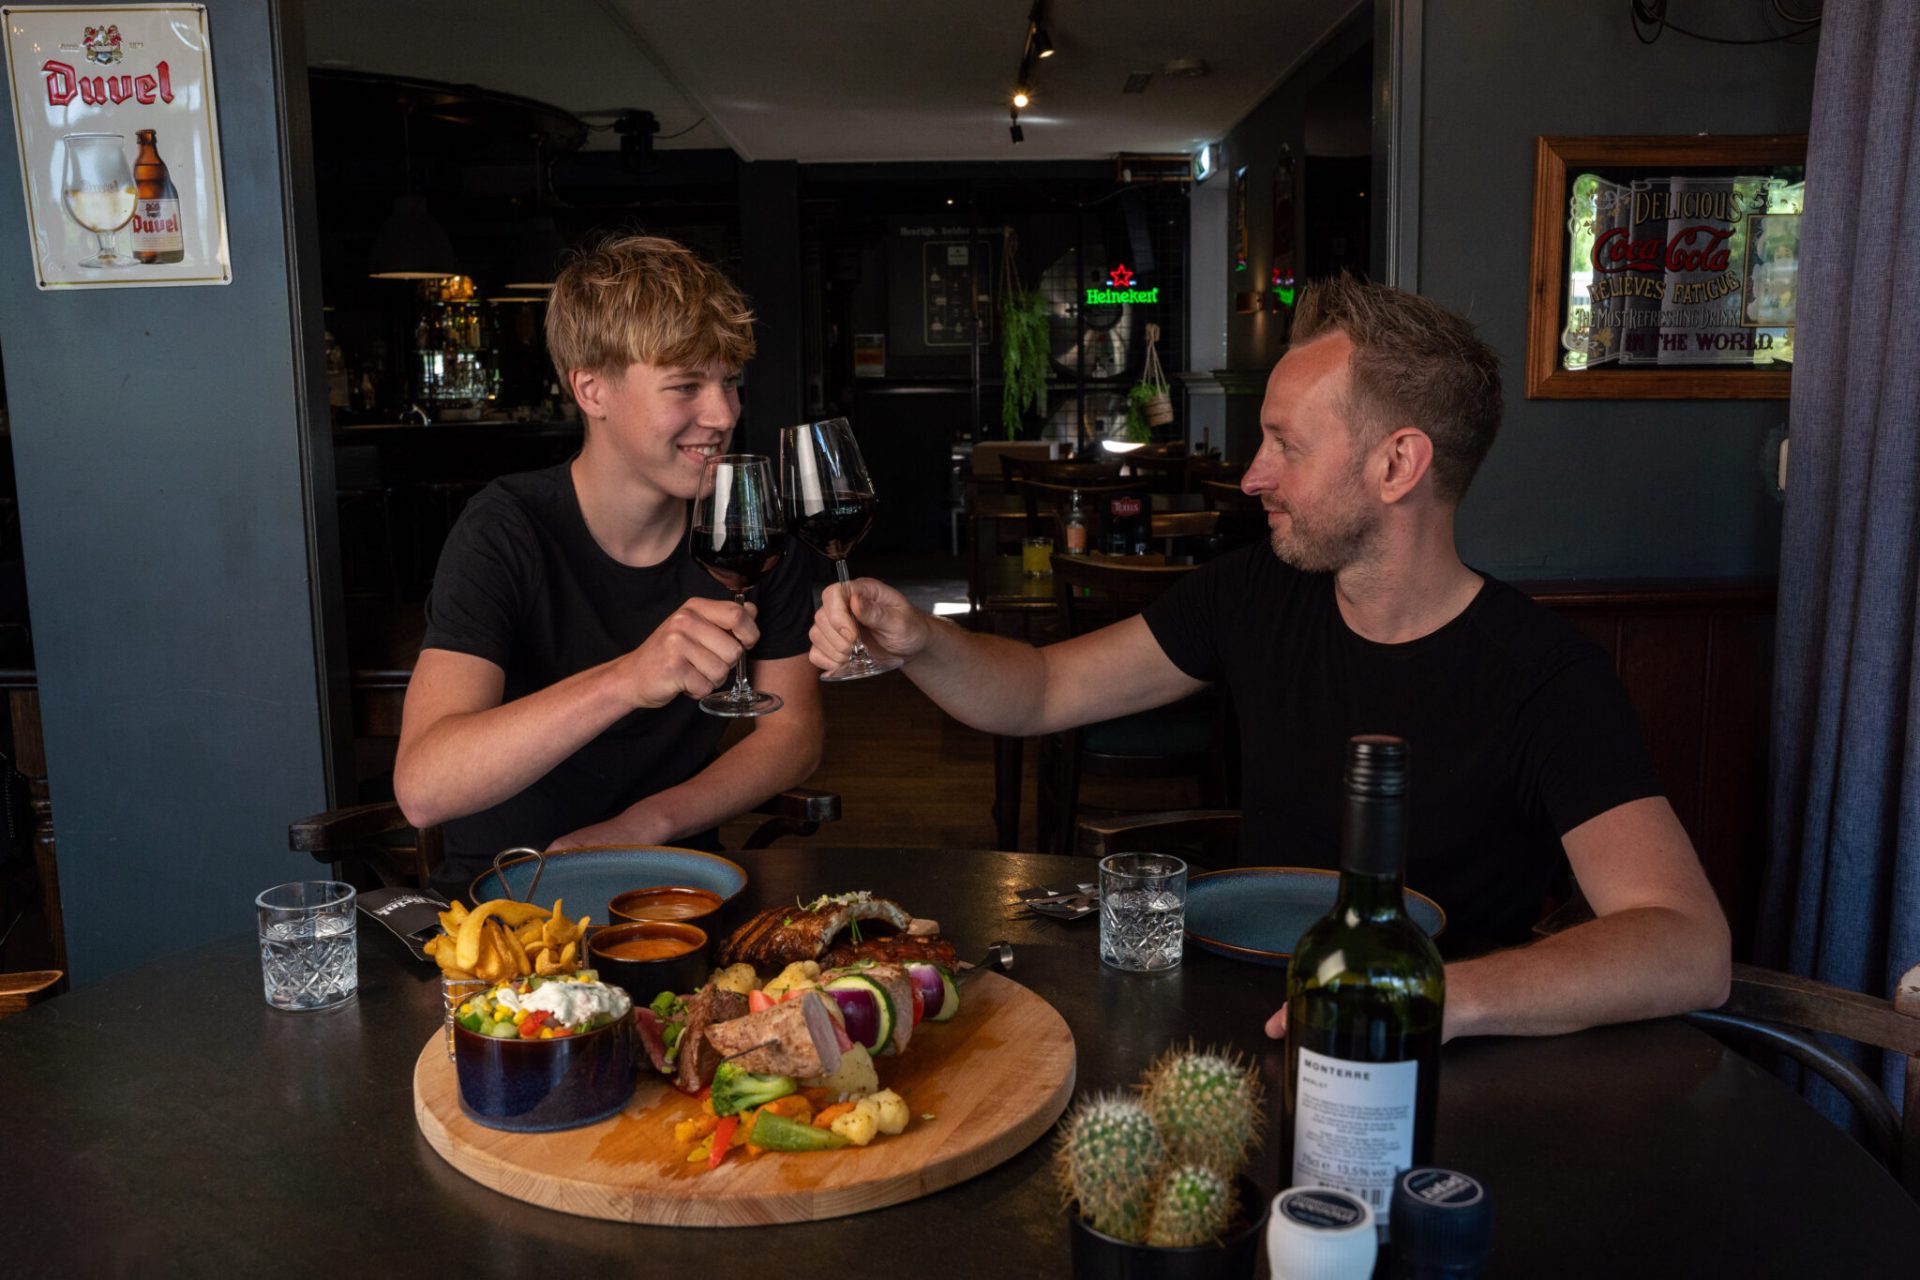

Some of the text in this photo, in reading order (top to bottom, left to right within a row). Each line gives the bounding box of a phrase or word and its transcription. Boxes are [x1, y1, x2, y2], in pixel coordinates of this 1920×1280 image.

[41, 59, 175, 106] Duvel
[1634, 190, 1744, 226] DELICIOUS
[132, 213, 179, 233] Duvel
[1085, 287, 1159, 305] Heineken
[1587, 270, 1741, 304] RELIEVES FATIGUE
[1626, 332, 1774, 351] IN THE WORLD
[1303, 1058, 1371, 1081] MONTERRE
